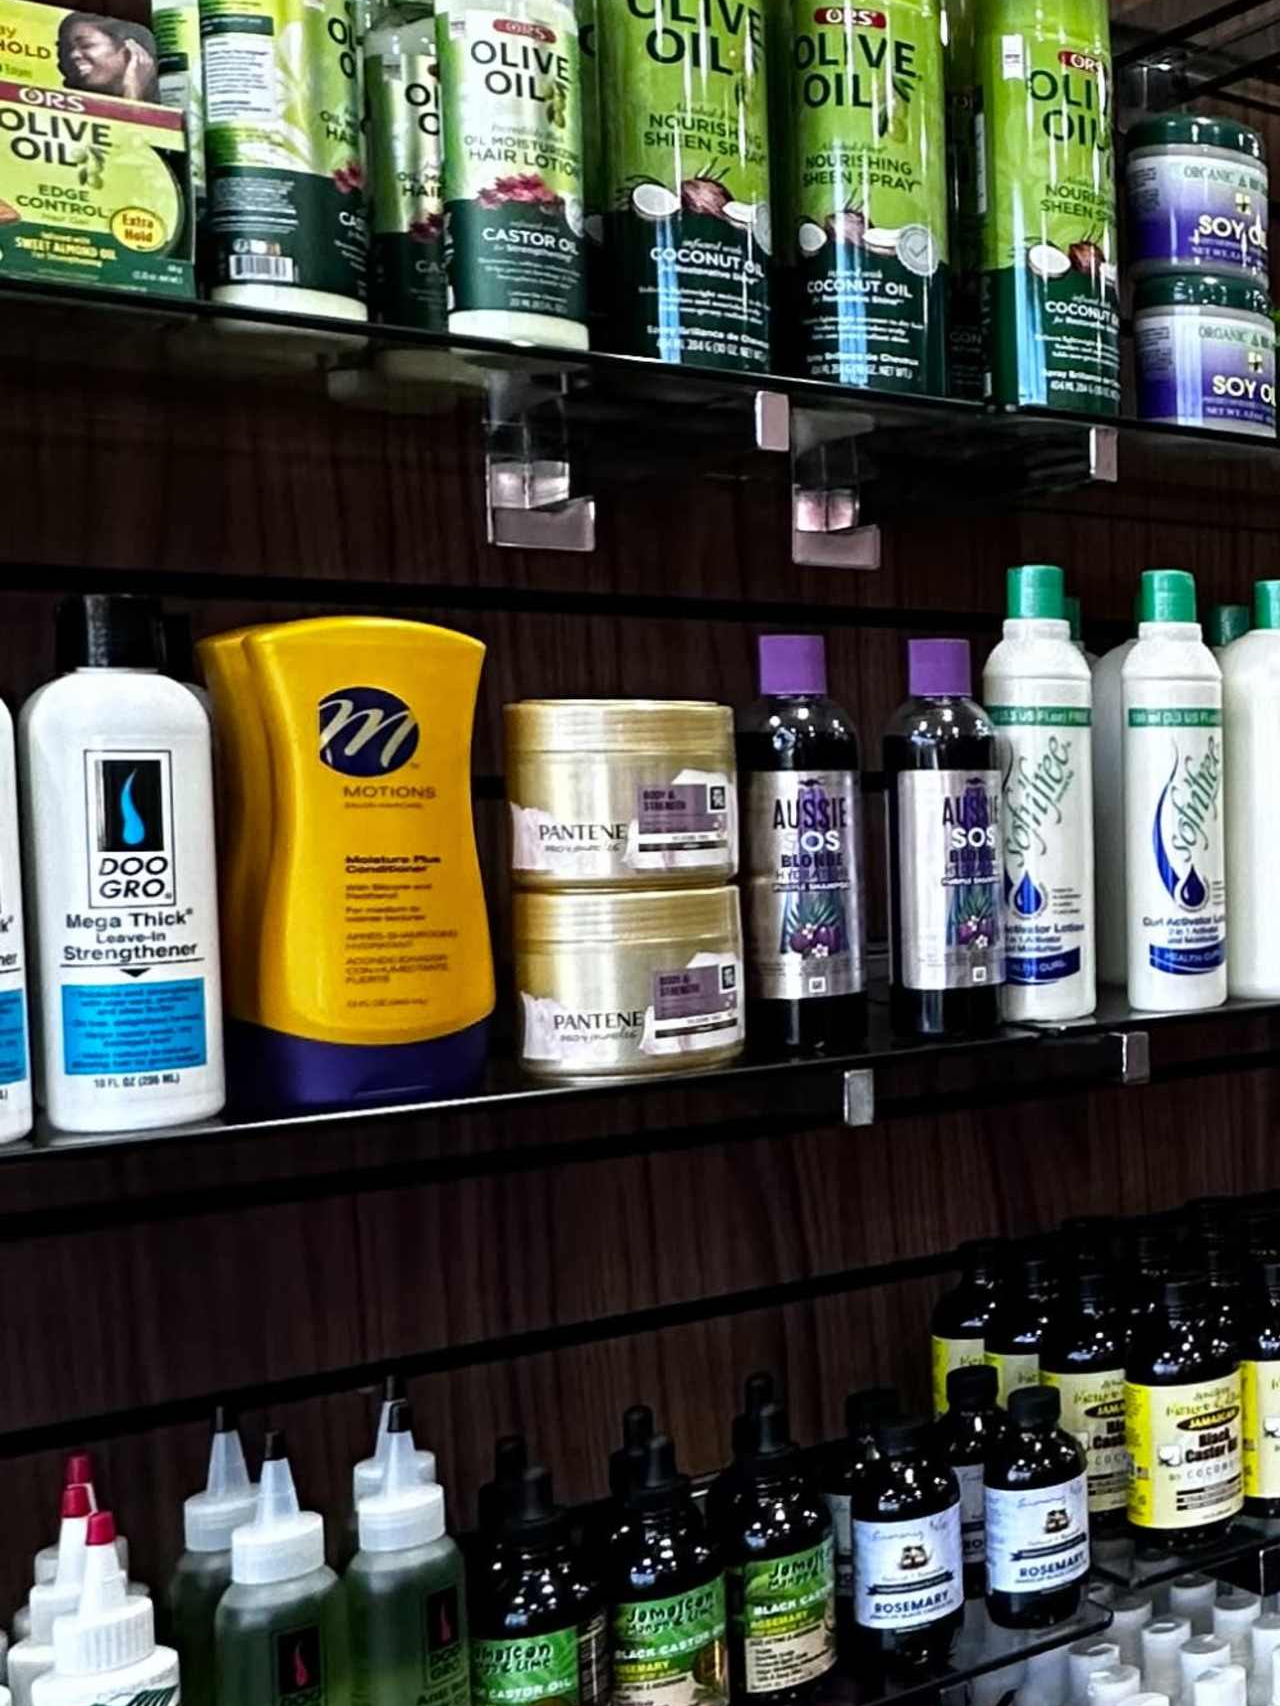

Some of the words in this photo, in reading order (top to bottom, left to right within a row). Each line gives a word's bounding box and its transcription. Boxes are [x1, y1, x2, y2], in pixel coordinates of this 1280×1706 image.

[824, 8, 878, 27] ORS
[470, 40, 570, 85] OLIVE
[645, 26, 734, 77] OIL
[794, 31, 918, 78] OLIVE
[484, 69, 544, 102] OIL
[803, 72, 874, 110] OIL
[19, 86, 86, 113] ORS
[0, 107, 112, 148] OLIVE
[11, 137, 78, 168] OIL
[468, 145, 517, 165] HAIR
[523, 152, 582, 181] LOTION
[805, 154, 913, 177] NOURISHING
[38, 183, 90, 203] EDGE
[802, 171, 855, 191] SHEEN
[857, 174, 917, 193] SPRAY
[16, 194, 108, 219] CONTROL
[121, 213, 155, 229] Extra
[1199, 214, 1246, 240] SOY
[123, 228, 153, 244] Hold
[482, 226, 554, 249] CASTOR
[649, 245, 742, 267] COCONUT
[806, 278, 882, 296] COCONUT
[885, 282, 913, 299] OIL
[1212, 376, 1256, 400] SOY
[342, 785, 437, 800] MOTIONS
[773, 797, 848, 830] AUSSIE
[942, 795, 999, 825] AUSSIE
[538, 823, 627, 842] PANTENE
[951, 827, 997, 849] SOS
[98, 856, 168, 878] DOO
[345, 855, 411, 865] Moisture
[412, 855, 442, 864] Plus
[345, 864, 428, 875] Conditioner
[98, 878, 168, 901] GRO
[95, 930, 167, 945] Leave-In
[63, 943, 198, 964] Strengthener
[552, 1010, 645, 1031] PANTENE
[1019, 1551, 1085, 1578] ROSEMARY
[874, 1591, 951, 1615] ROSEMARY
